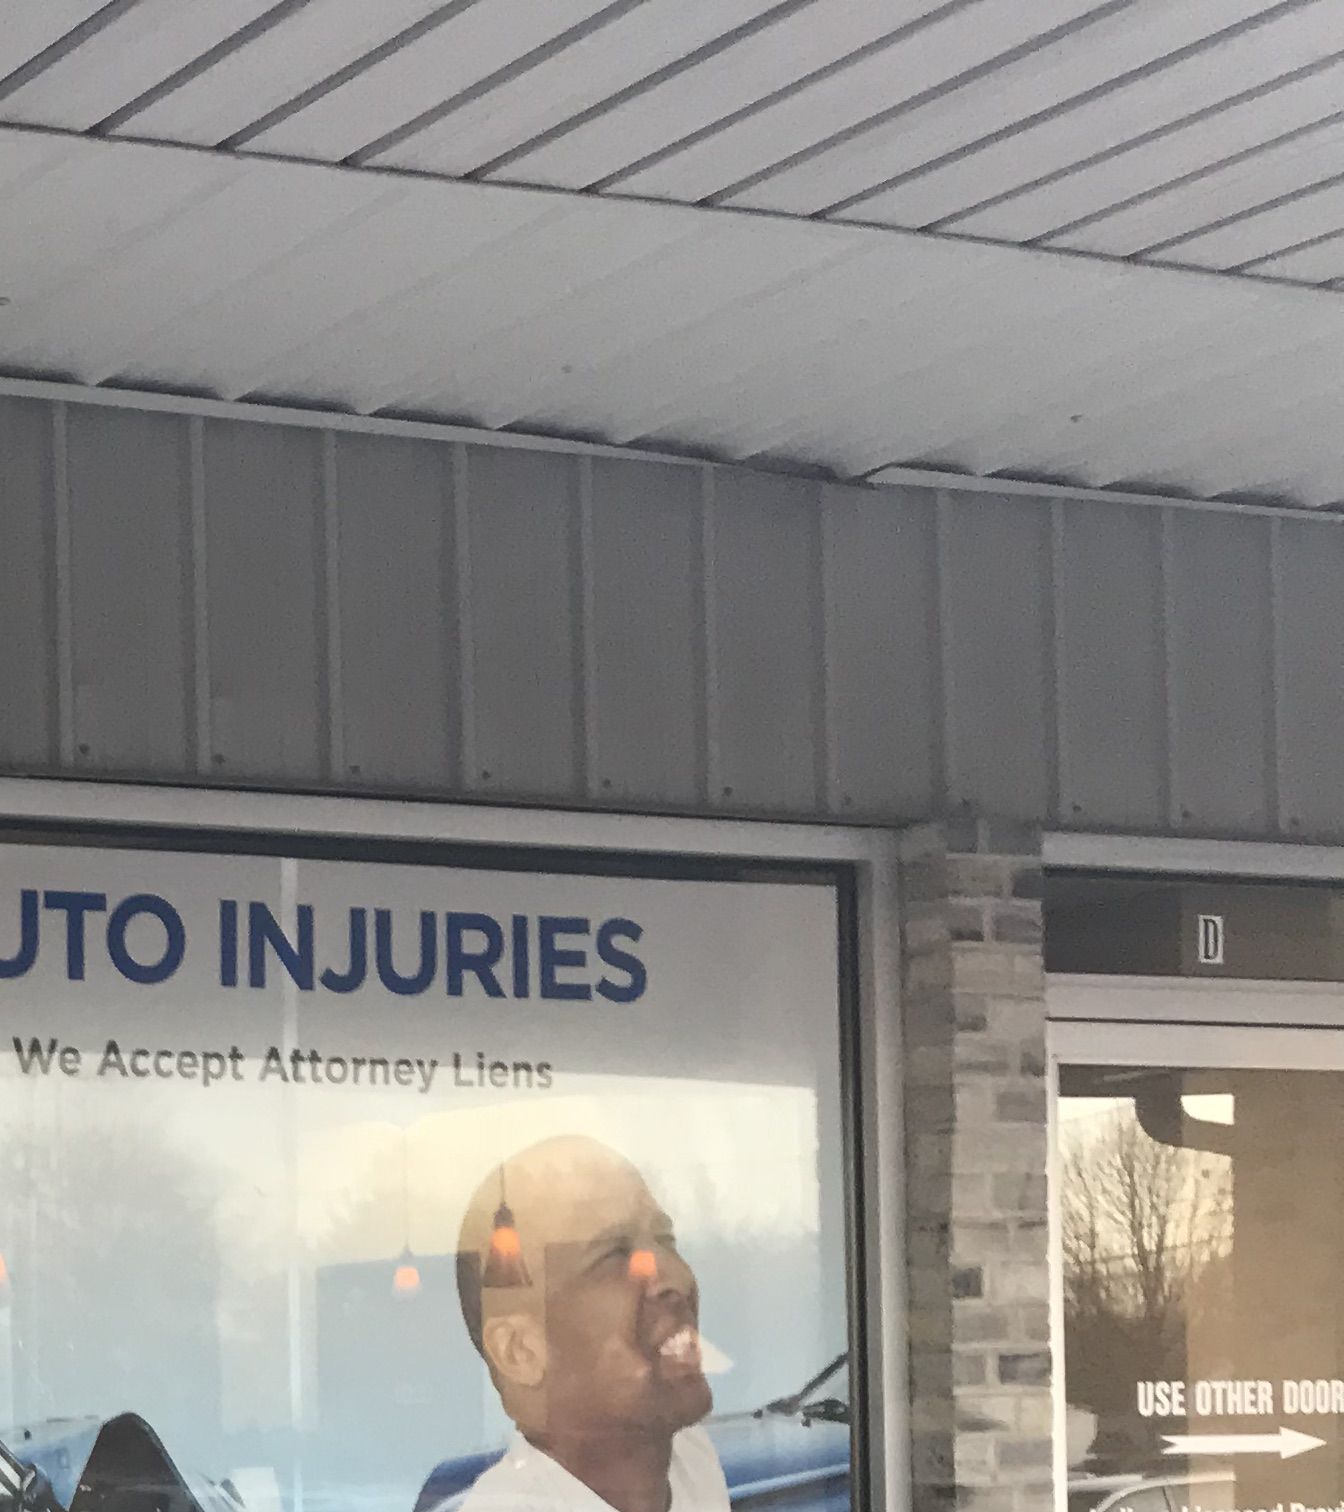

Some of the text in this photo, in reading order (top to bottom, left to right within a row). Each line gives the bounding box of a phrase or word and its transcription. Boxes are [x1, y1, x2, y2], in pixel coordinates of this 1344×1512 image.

[220, 898, 647, 1003] INJURIES
[14, 1036, 553, 1094] We Accept Attorney Liens
[1137, 1379, 1344, 1416] USE OTHER DOOR
